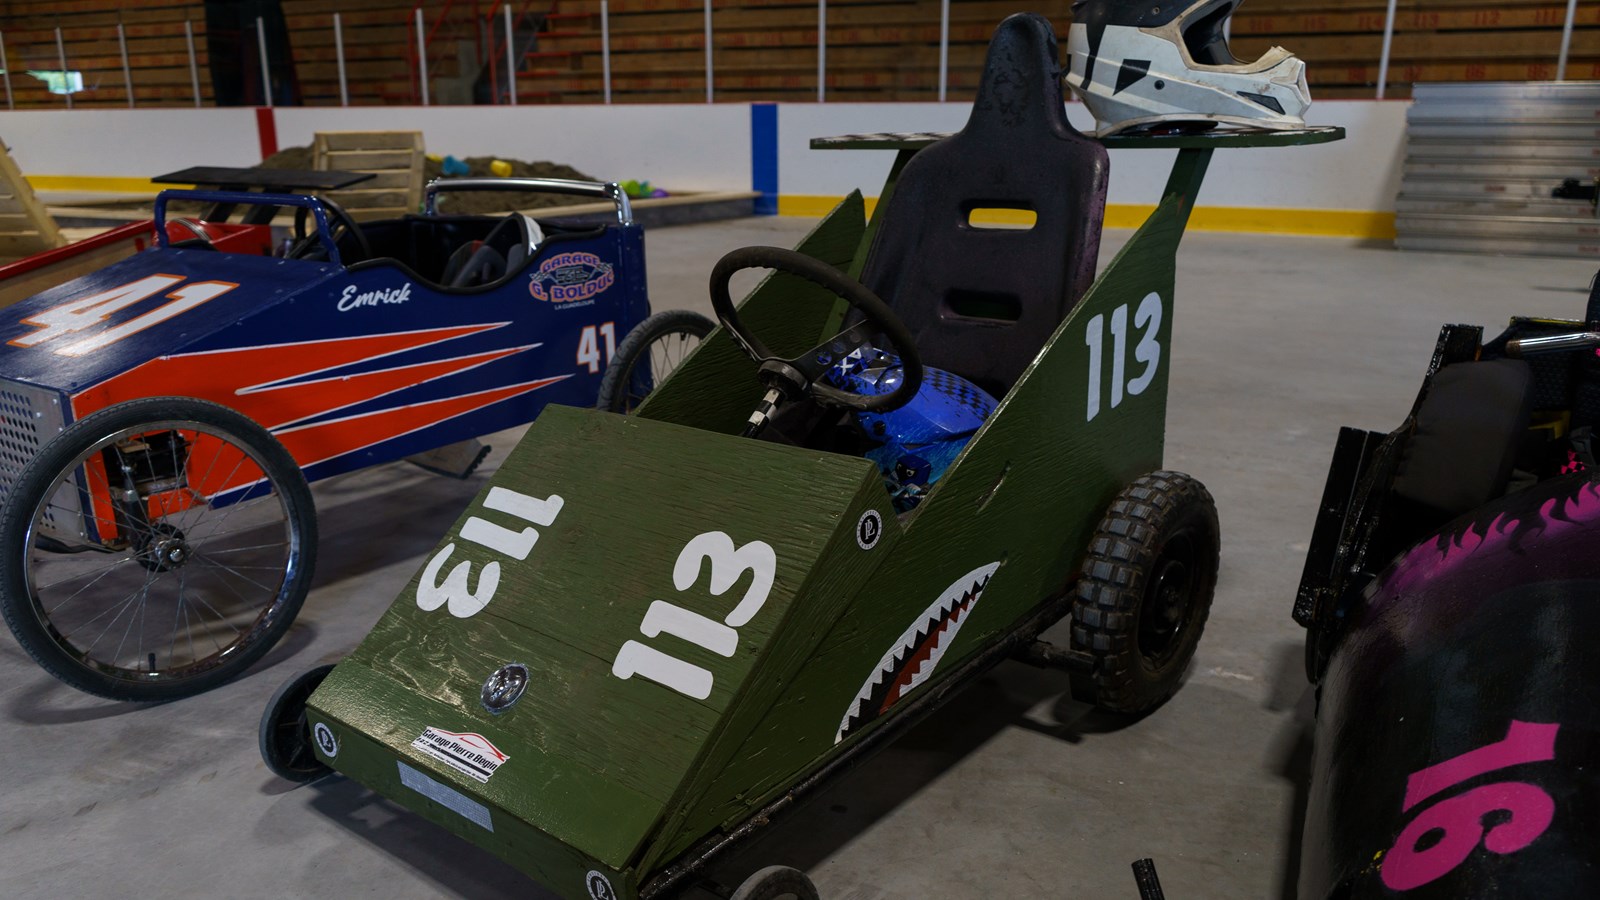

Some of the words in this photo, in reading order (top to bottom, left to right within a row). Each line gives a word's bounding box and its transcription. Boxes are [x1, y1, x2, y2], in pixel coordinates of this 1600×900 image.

[1473, 10, 1501, 25] 112
[1535, 8, 1558, 23] 111
[540, 252, 601, 274] GARAGE
[336, 282, 412, 313] Emrick
[550, 272, 615, 303] BOLDUC
[6, 272, 241, 358] 41
[576, 321, 616, 374] 41
[1085, 291, 1163, 422] 113
[415, 486, 565, 619] 113
[611, 529, 777, 700] 113
[422, 728, 451, 748] Garage
[448, 741, 474, 760] Pierre
[1380, 719, 1561, 892] 16
